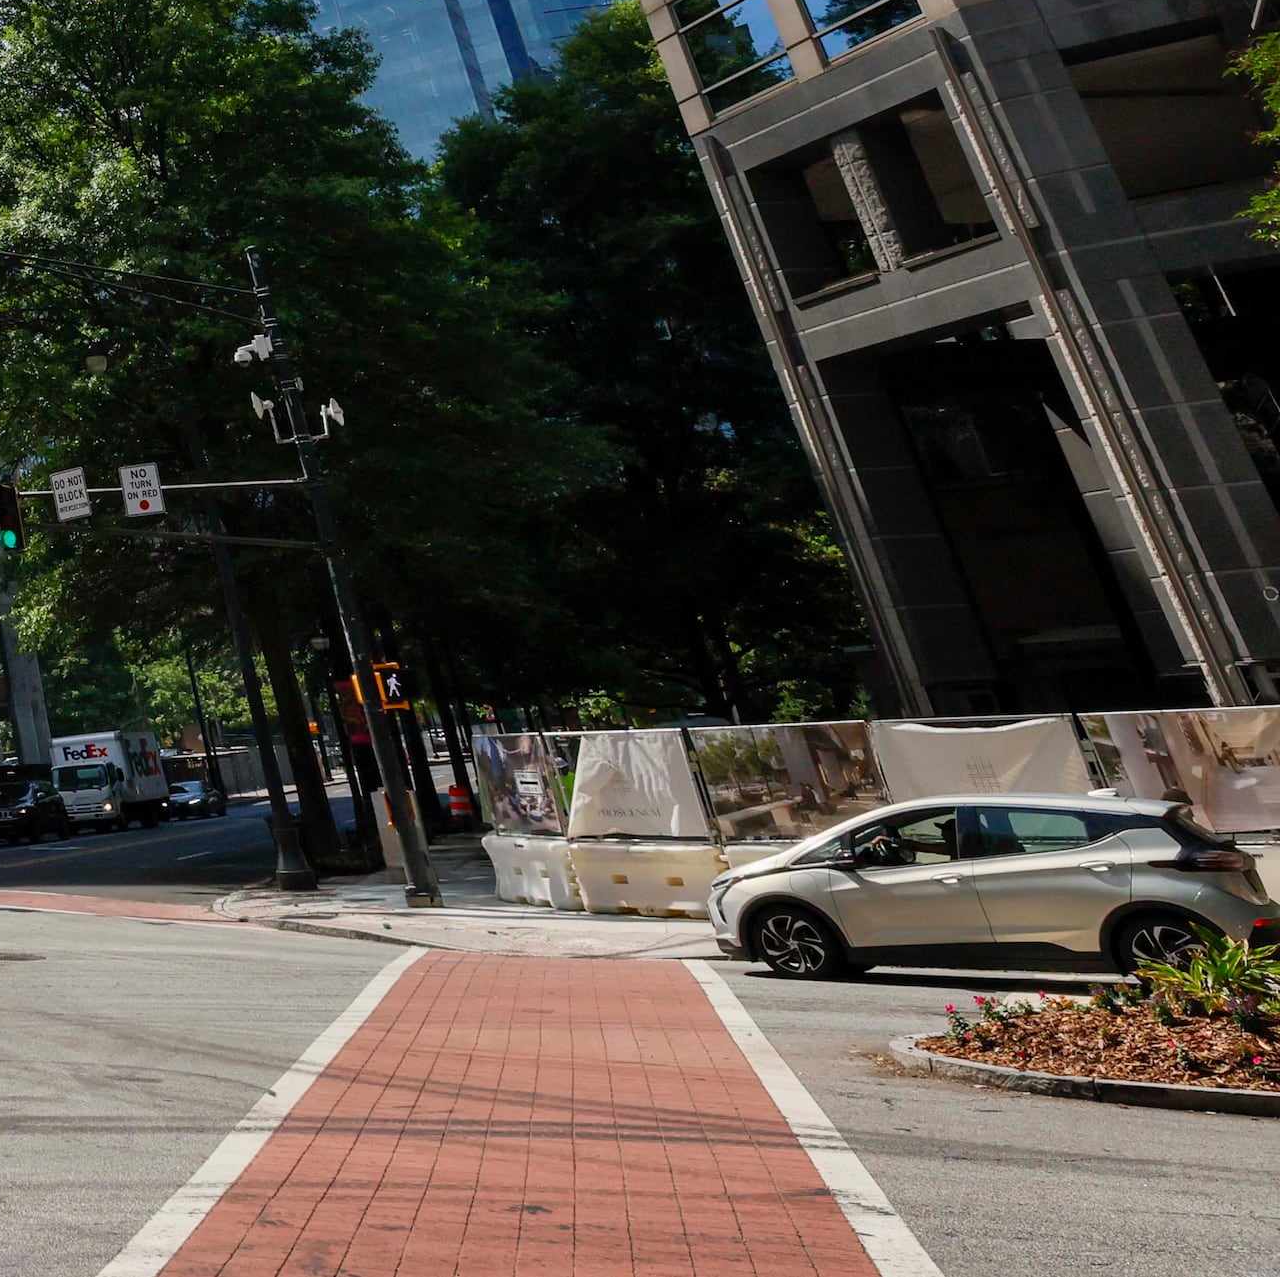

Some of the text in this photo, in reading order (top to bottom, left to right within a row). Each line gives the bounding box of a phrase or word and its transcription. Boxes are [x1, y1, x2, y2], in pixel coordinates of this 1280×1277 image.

[130, 469, 147, 479] NO
[54, 475, 83, 490] DO NOT
[130, 480, 152, 489] TURN
[58, 489, 85, 503] BLOCK
[127, 489, 158, 500] ON RED
[63, 743, 108, 761] FedEx
